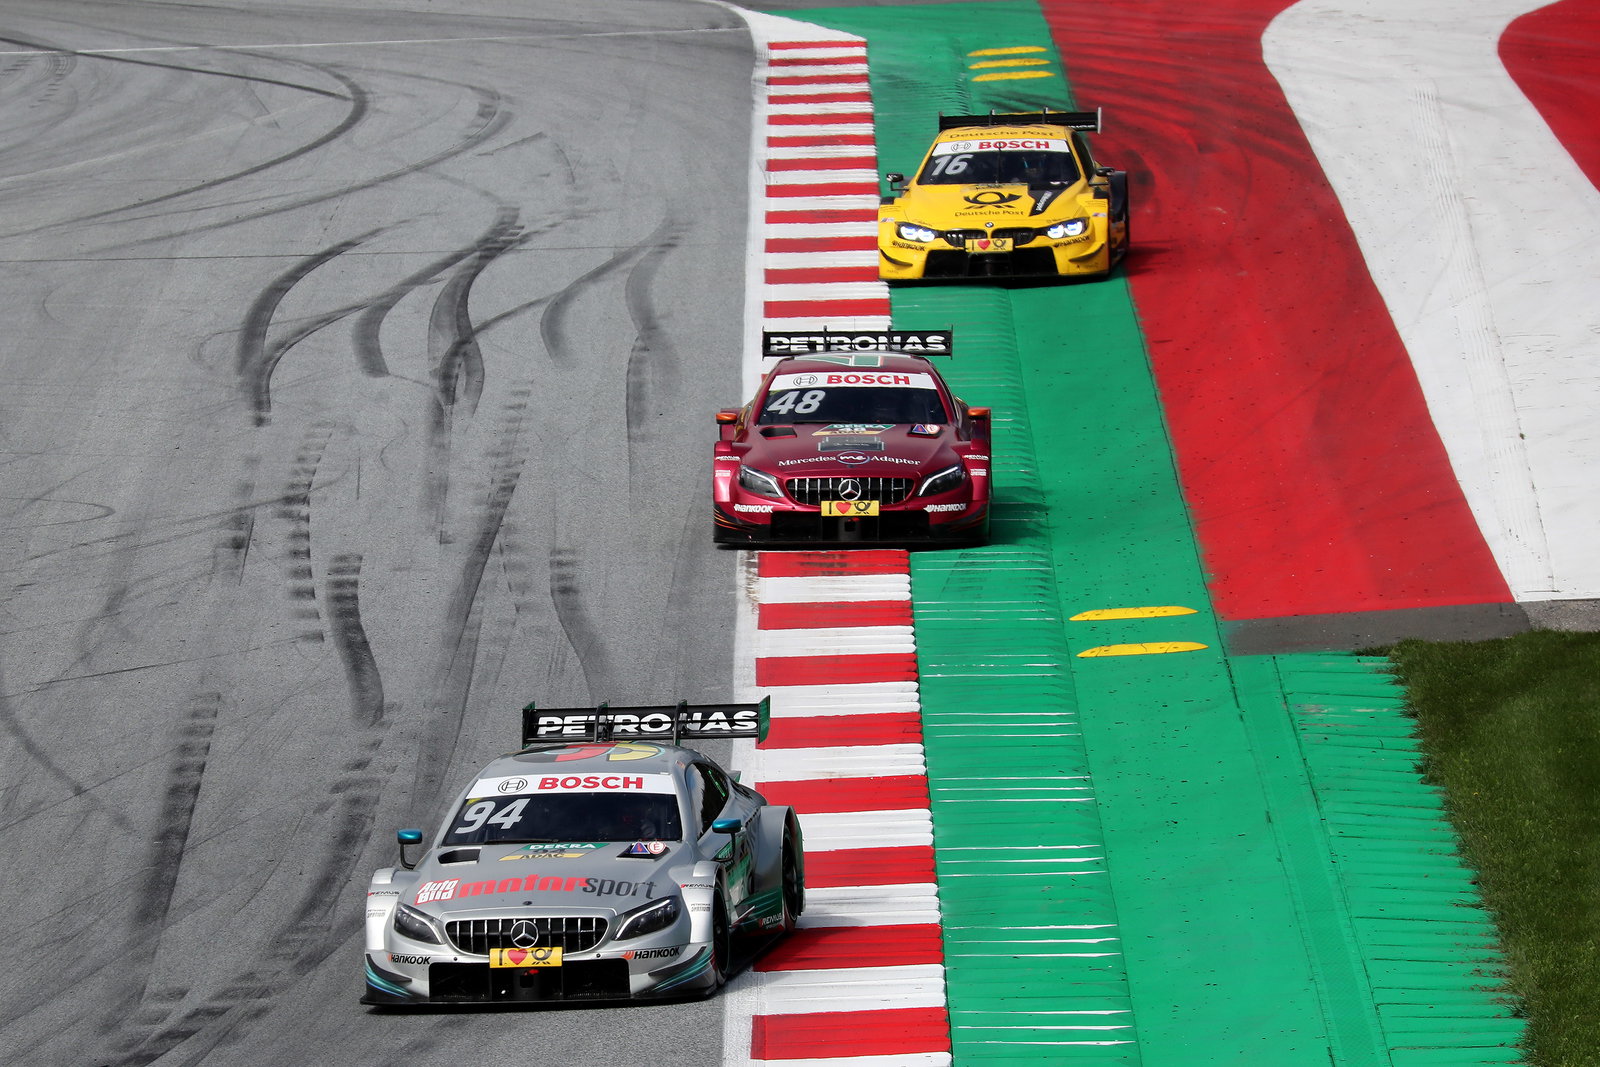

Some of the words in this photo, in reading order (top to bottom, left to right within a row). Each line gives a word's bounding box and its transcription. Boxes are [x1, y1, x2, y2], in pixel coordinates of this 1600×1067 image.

[978, 140, 1050, 150] BOSCH
[931, 154, 974, 176] 16
[826, 374, 910, 385] BOSCH
[766, 389, 826, 415] 48
[778, 455, 837, 467] Mercedes
[870, 455, 921, 465] Adapter
[538, 776, 644, 790] BOSCH
[455, 798, 531, 834] 94
[417, 880, 459, 894] Auto
[416, 889, 454, 904] Bild
